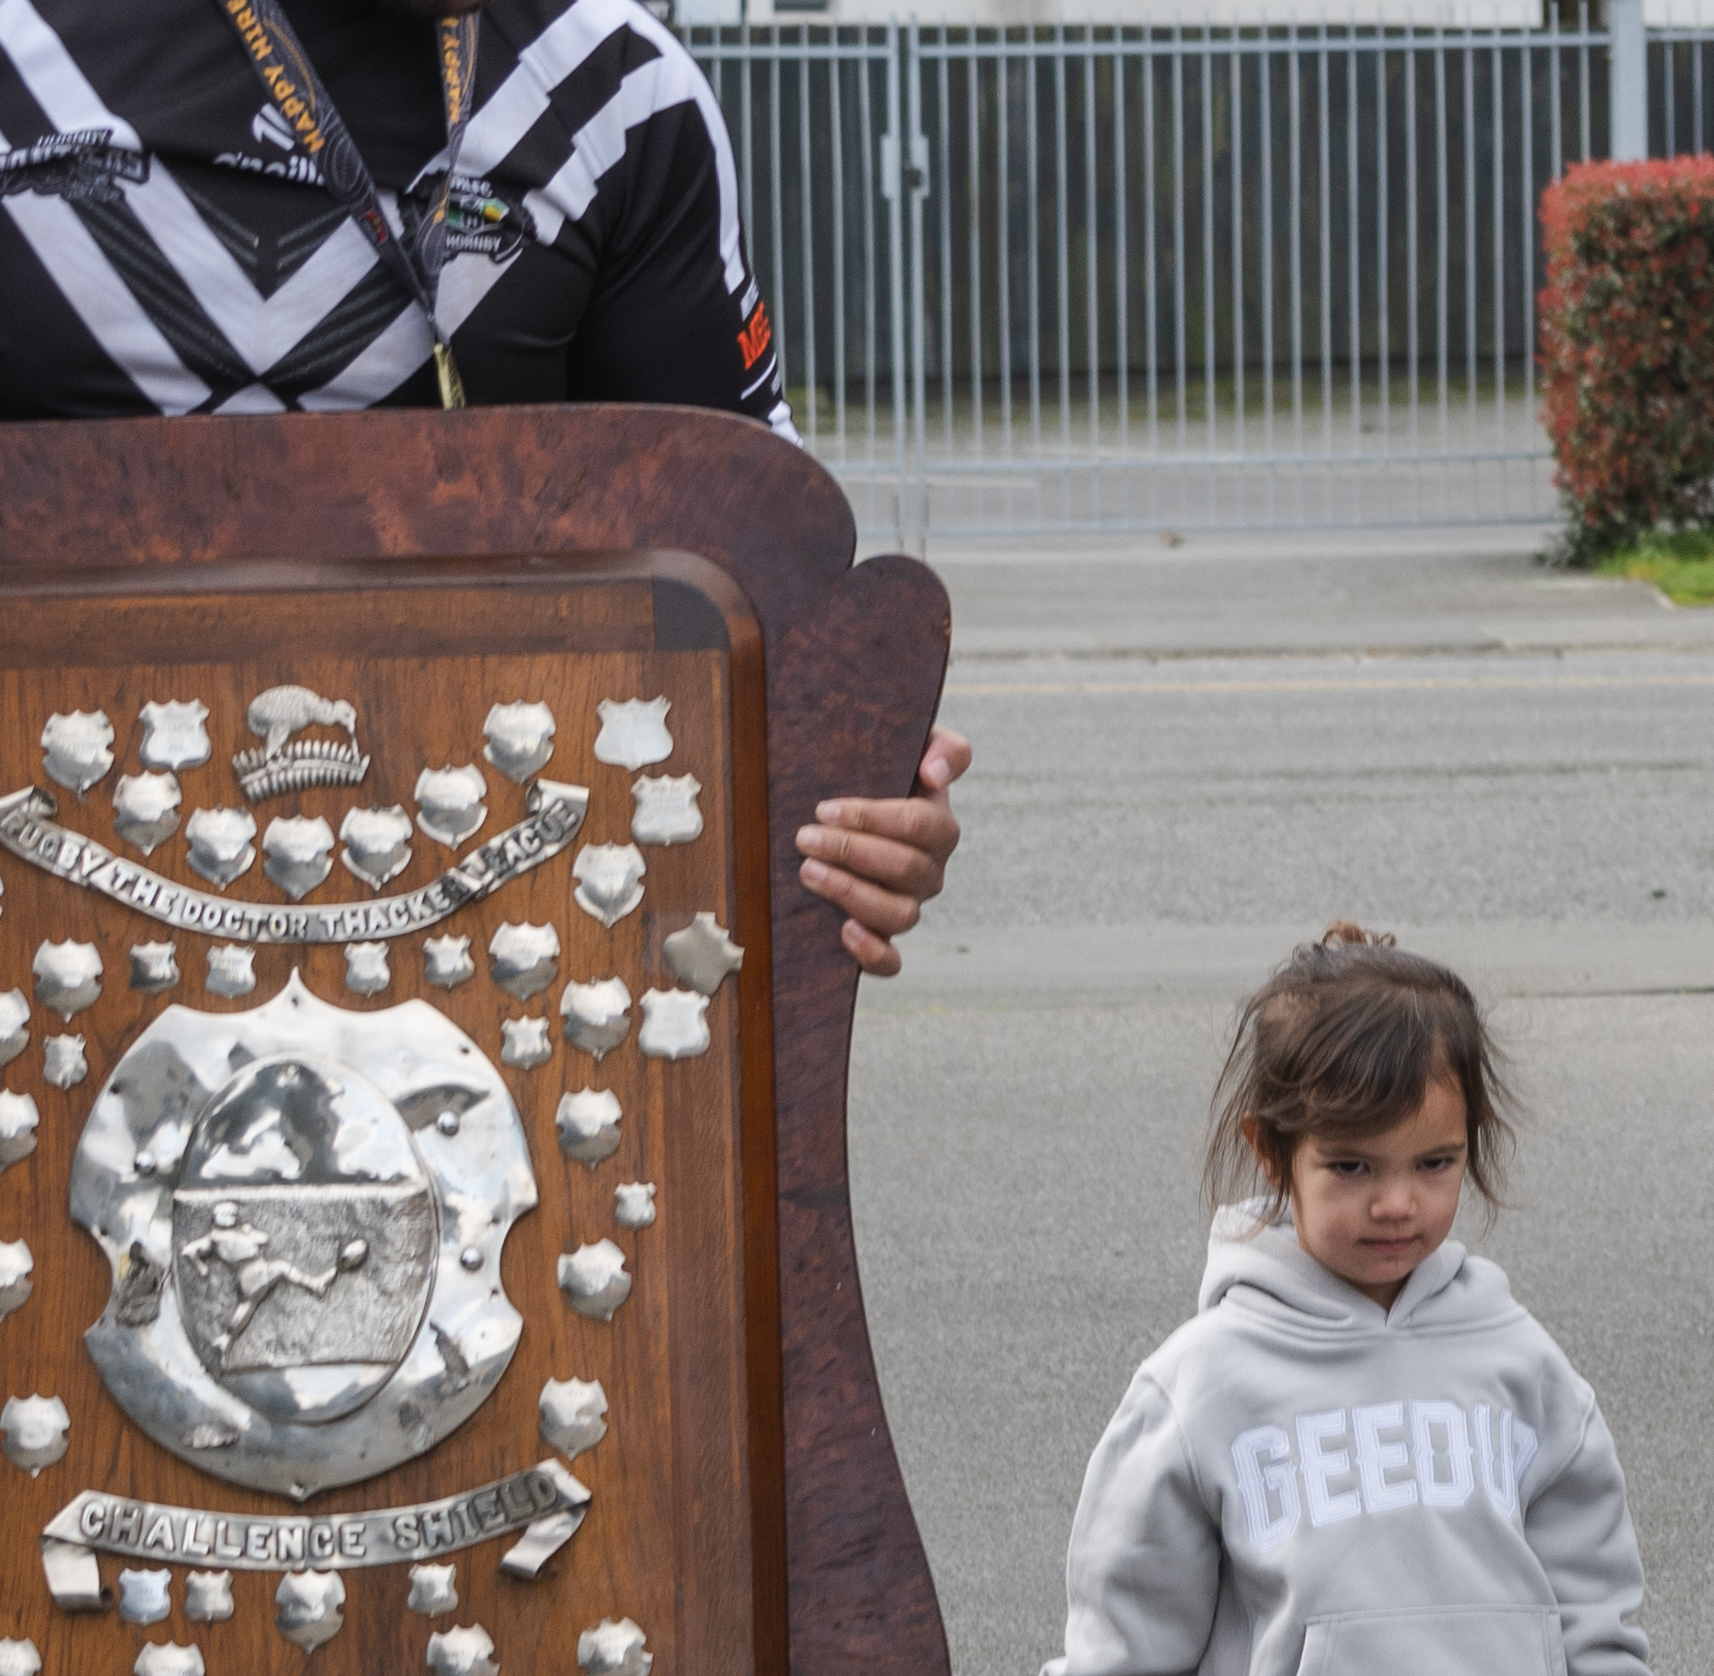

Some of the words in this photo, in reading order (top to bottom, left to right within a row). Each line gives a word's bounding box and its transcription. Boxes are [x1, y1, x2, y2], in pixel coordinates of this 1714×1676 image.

[263, 63, 326, 154] HAPPY
[112, 863, 179, 916] THE
[183, 902, 308, 940] DOCTOR
[394, 1470, 560, 1552] SHIELD
